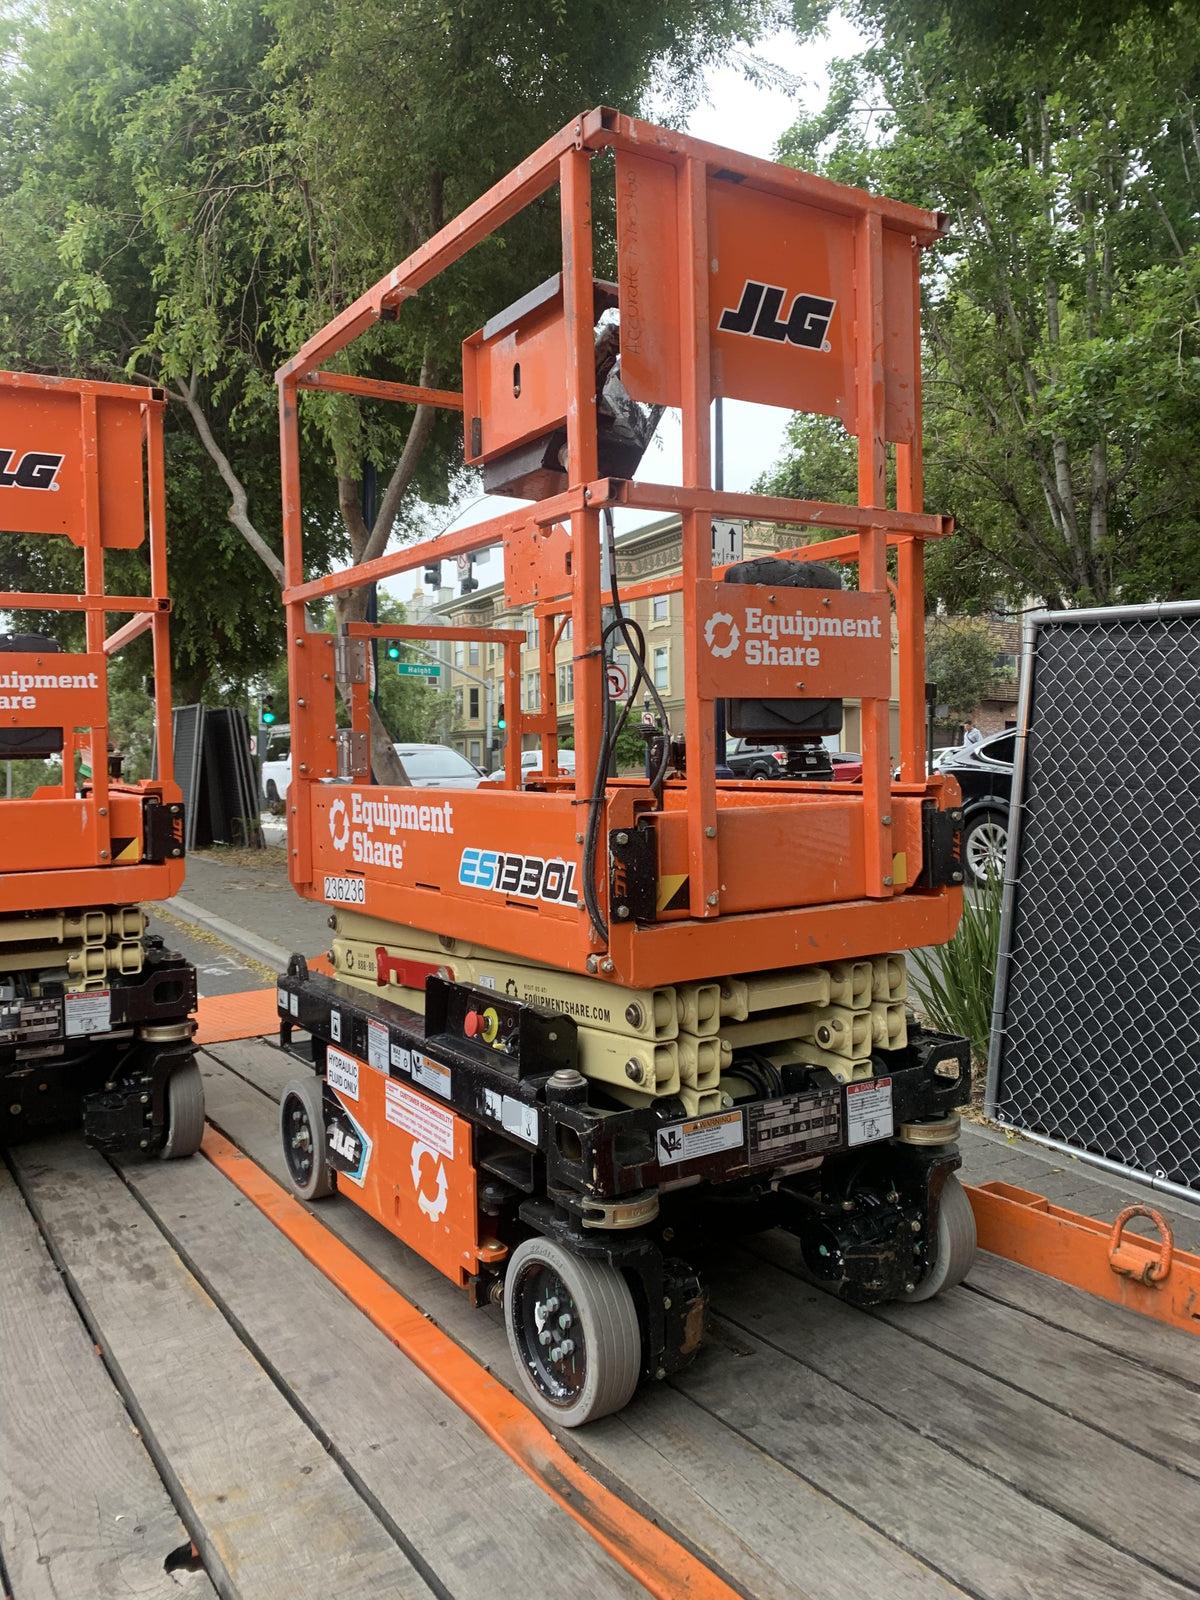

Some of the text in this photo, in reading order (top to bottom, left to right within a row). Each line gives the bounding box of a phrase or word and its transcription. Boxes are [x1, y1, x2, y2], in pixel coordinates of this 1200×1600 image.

[717, 279, 836, 351] JLG
[0, 448, 65, 491] LG
[745, 608, 881, 641] Equipment
[745, 639, 820, 667] Share
[0, 671, 99, 692] uipment
[408, 666, 431, 675] Haight
[0, 696, 36, 709] are
[351, 793, 454, 835] Equipment
[352, 831, 403, 869] Share
[325, 877, 364, 902] 236236
[459, 849, 578, 903] ES1330L
[328, 1052, 358, 1078] HYDRAULIC
[328, 1069, 358, 1096] FLUID ONLY
